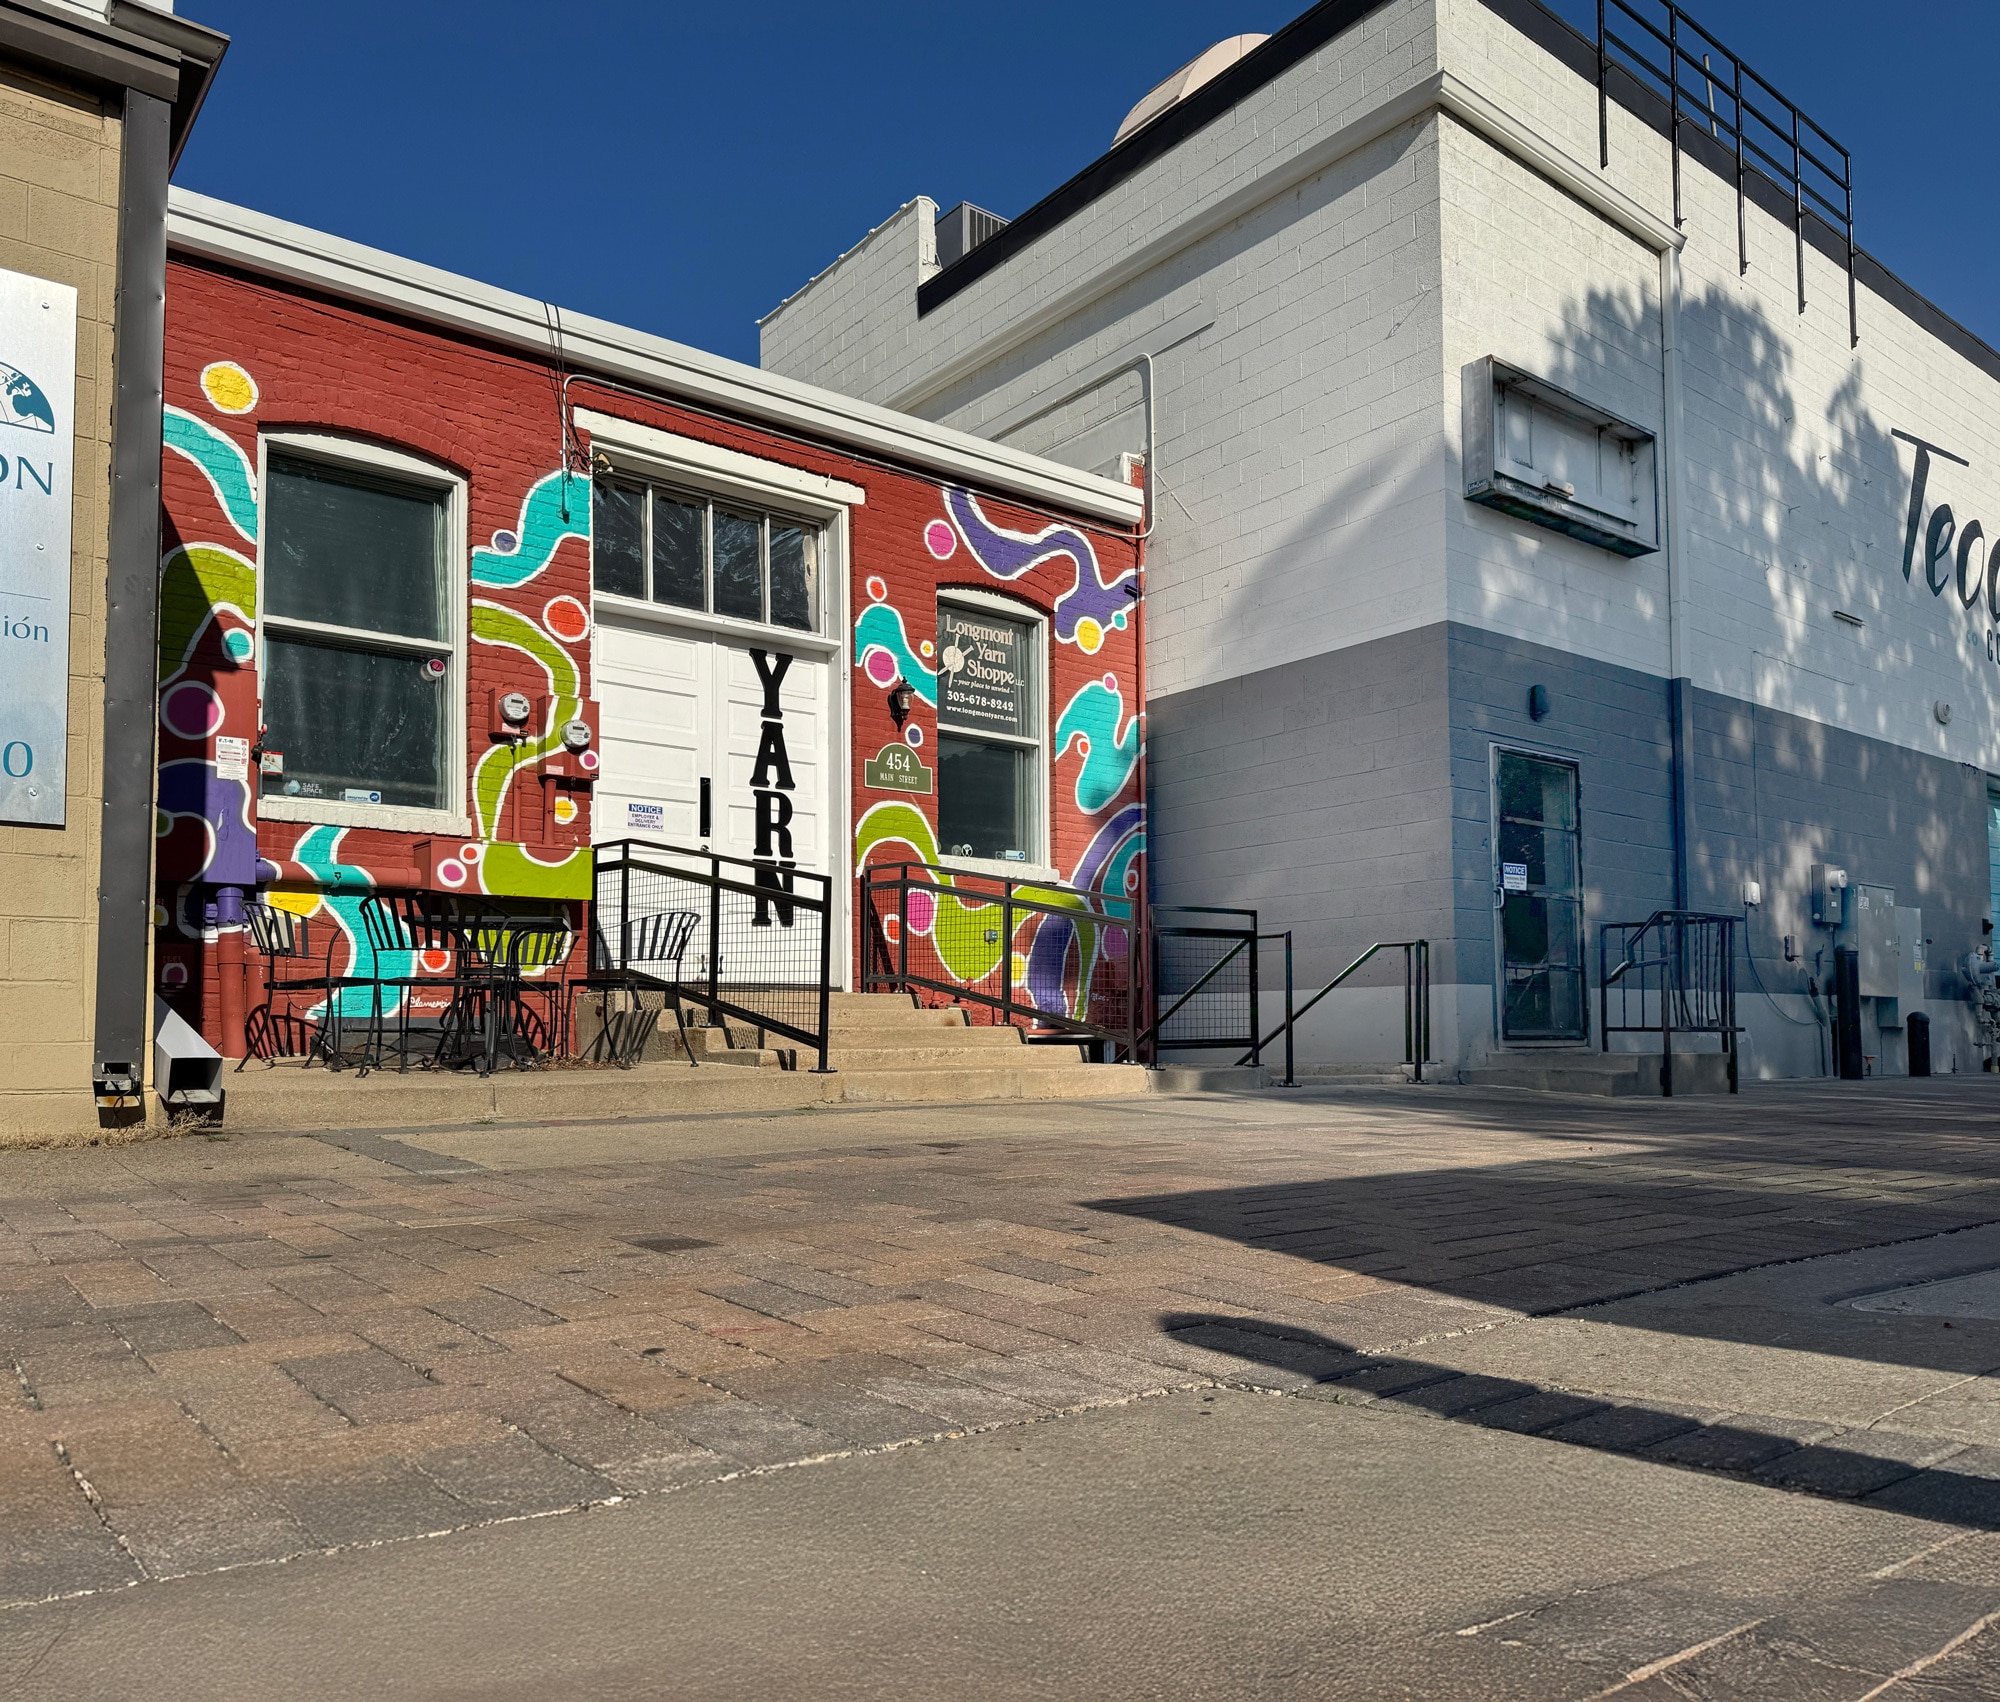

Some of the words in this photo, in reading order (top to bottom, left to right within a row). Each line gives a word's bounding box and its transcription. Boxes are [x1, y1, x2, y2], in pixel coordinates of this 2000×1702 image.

[946, 614, 1014, 646] Longmont
[976, 641, 1006, 664] Yarn
[967, 659, 1015, 686] Shoppe
[1015, 679, 1025, 687] LLC
[947, 690, 1014, 712] 303-678-8242
[946, 705, 1018, 723] www.longmontyarn.com
[886, 752, 910, 771] 454
[749, 647, 797, 928] YARN
[880, 773, 894, 781] MAIN
[899, 774, 918, 785] STREET
[631, 805, 662, 814] NOTICE
[1505, 865, 1525, 875] NOTICE
